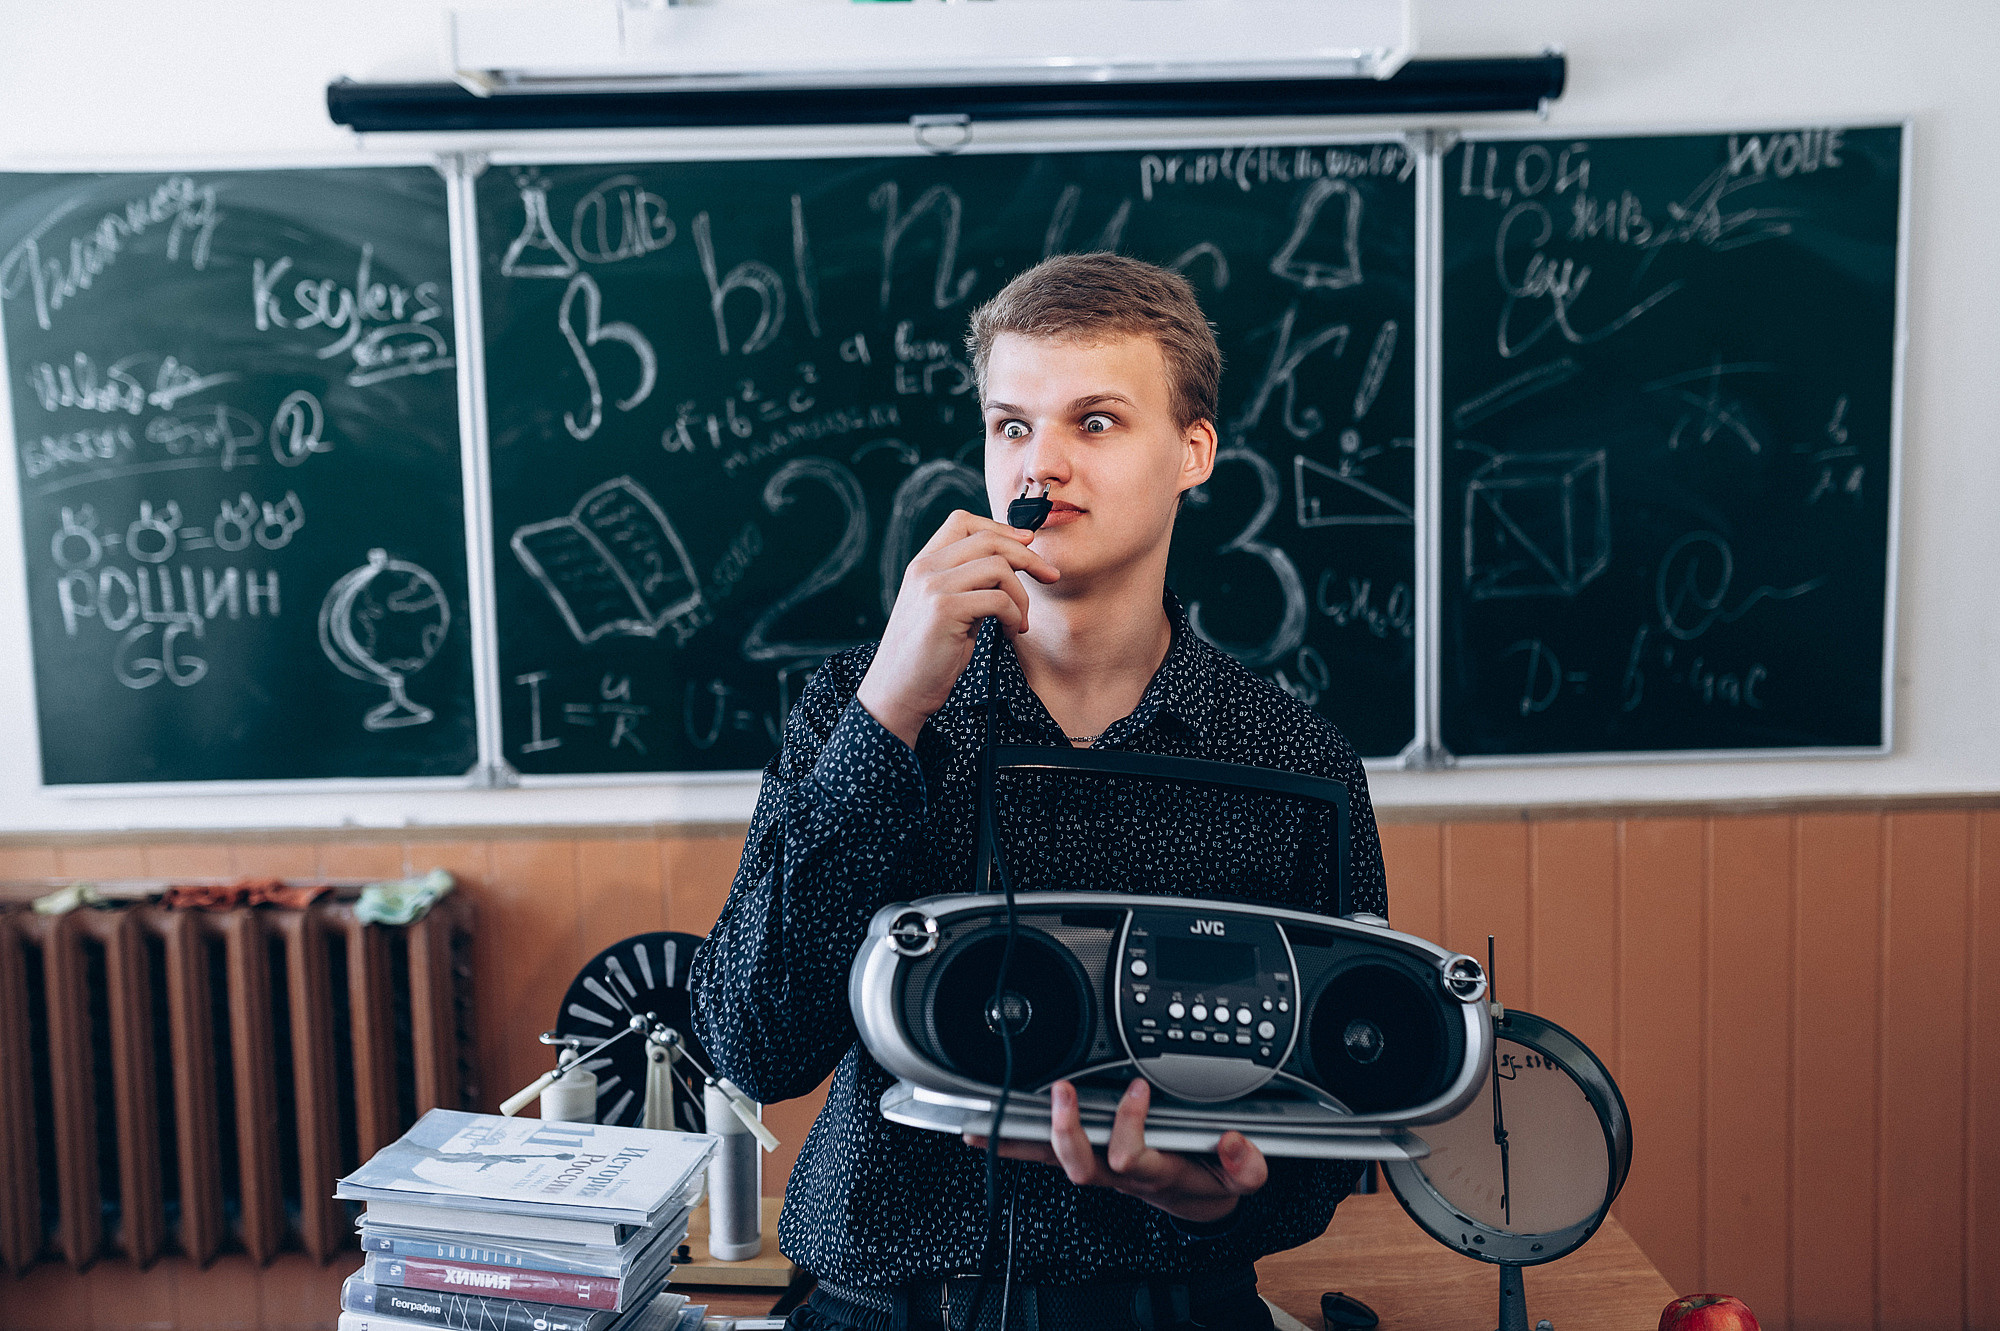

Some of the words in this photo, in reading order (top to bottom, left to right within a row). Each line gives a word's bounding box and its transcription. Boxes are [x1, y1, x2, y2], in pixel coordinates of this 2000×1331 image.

[58, 564, 281, 637] РОЩИН
[1189, 919, 1226, 936] JVC
[521, 1125, 596, 1148] 11
[541, 1152, 607, 1194] России
[576, 1147, 649, 1197] История
[443, 1268, 511, 1290] ХИМИЯ
[577, 1283, 591, 1300] 11
[391, 1297, 441, 1315] География
